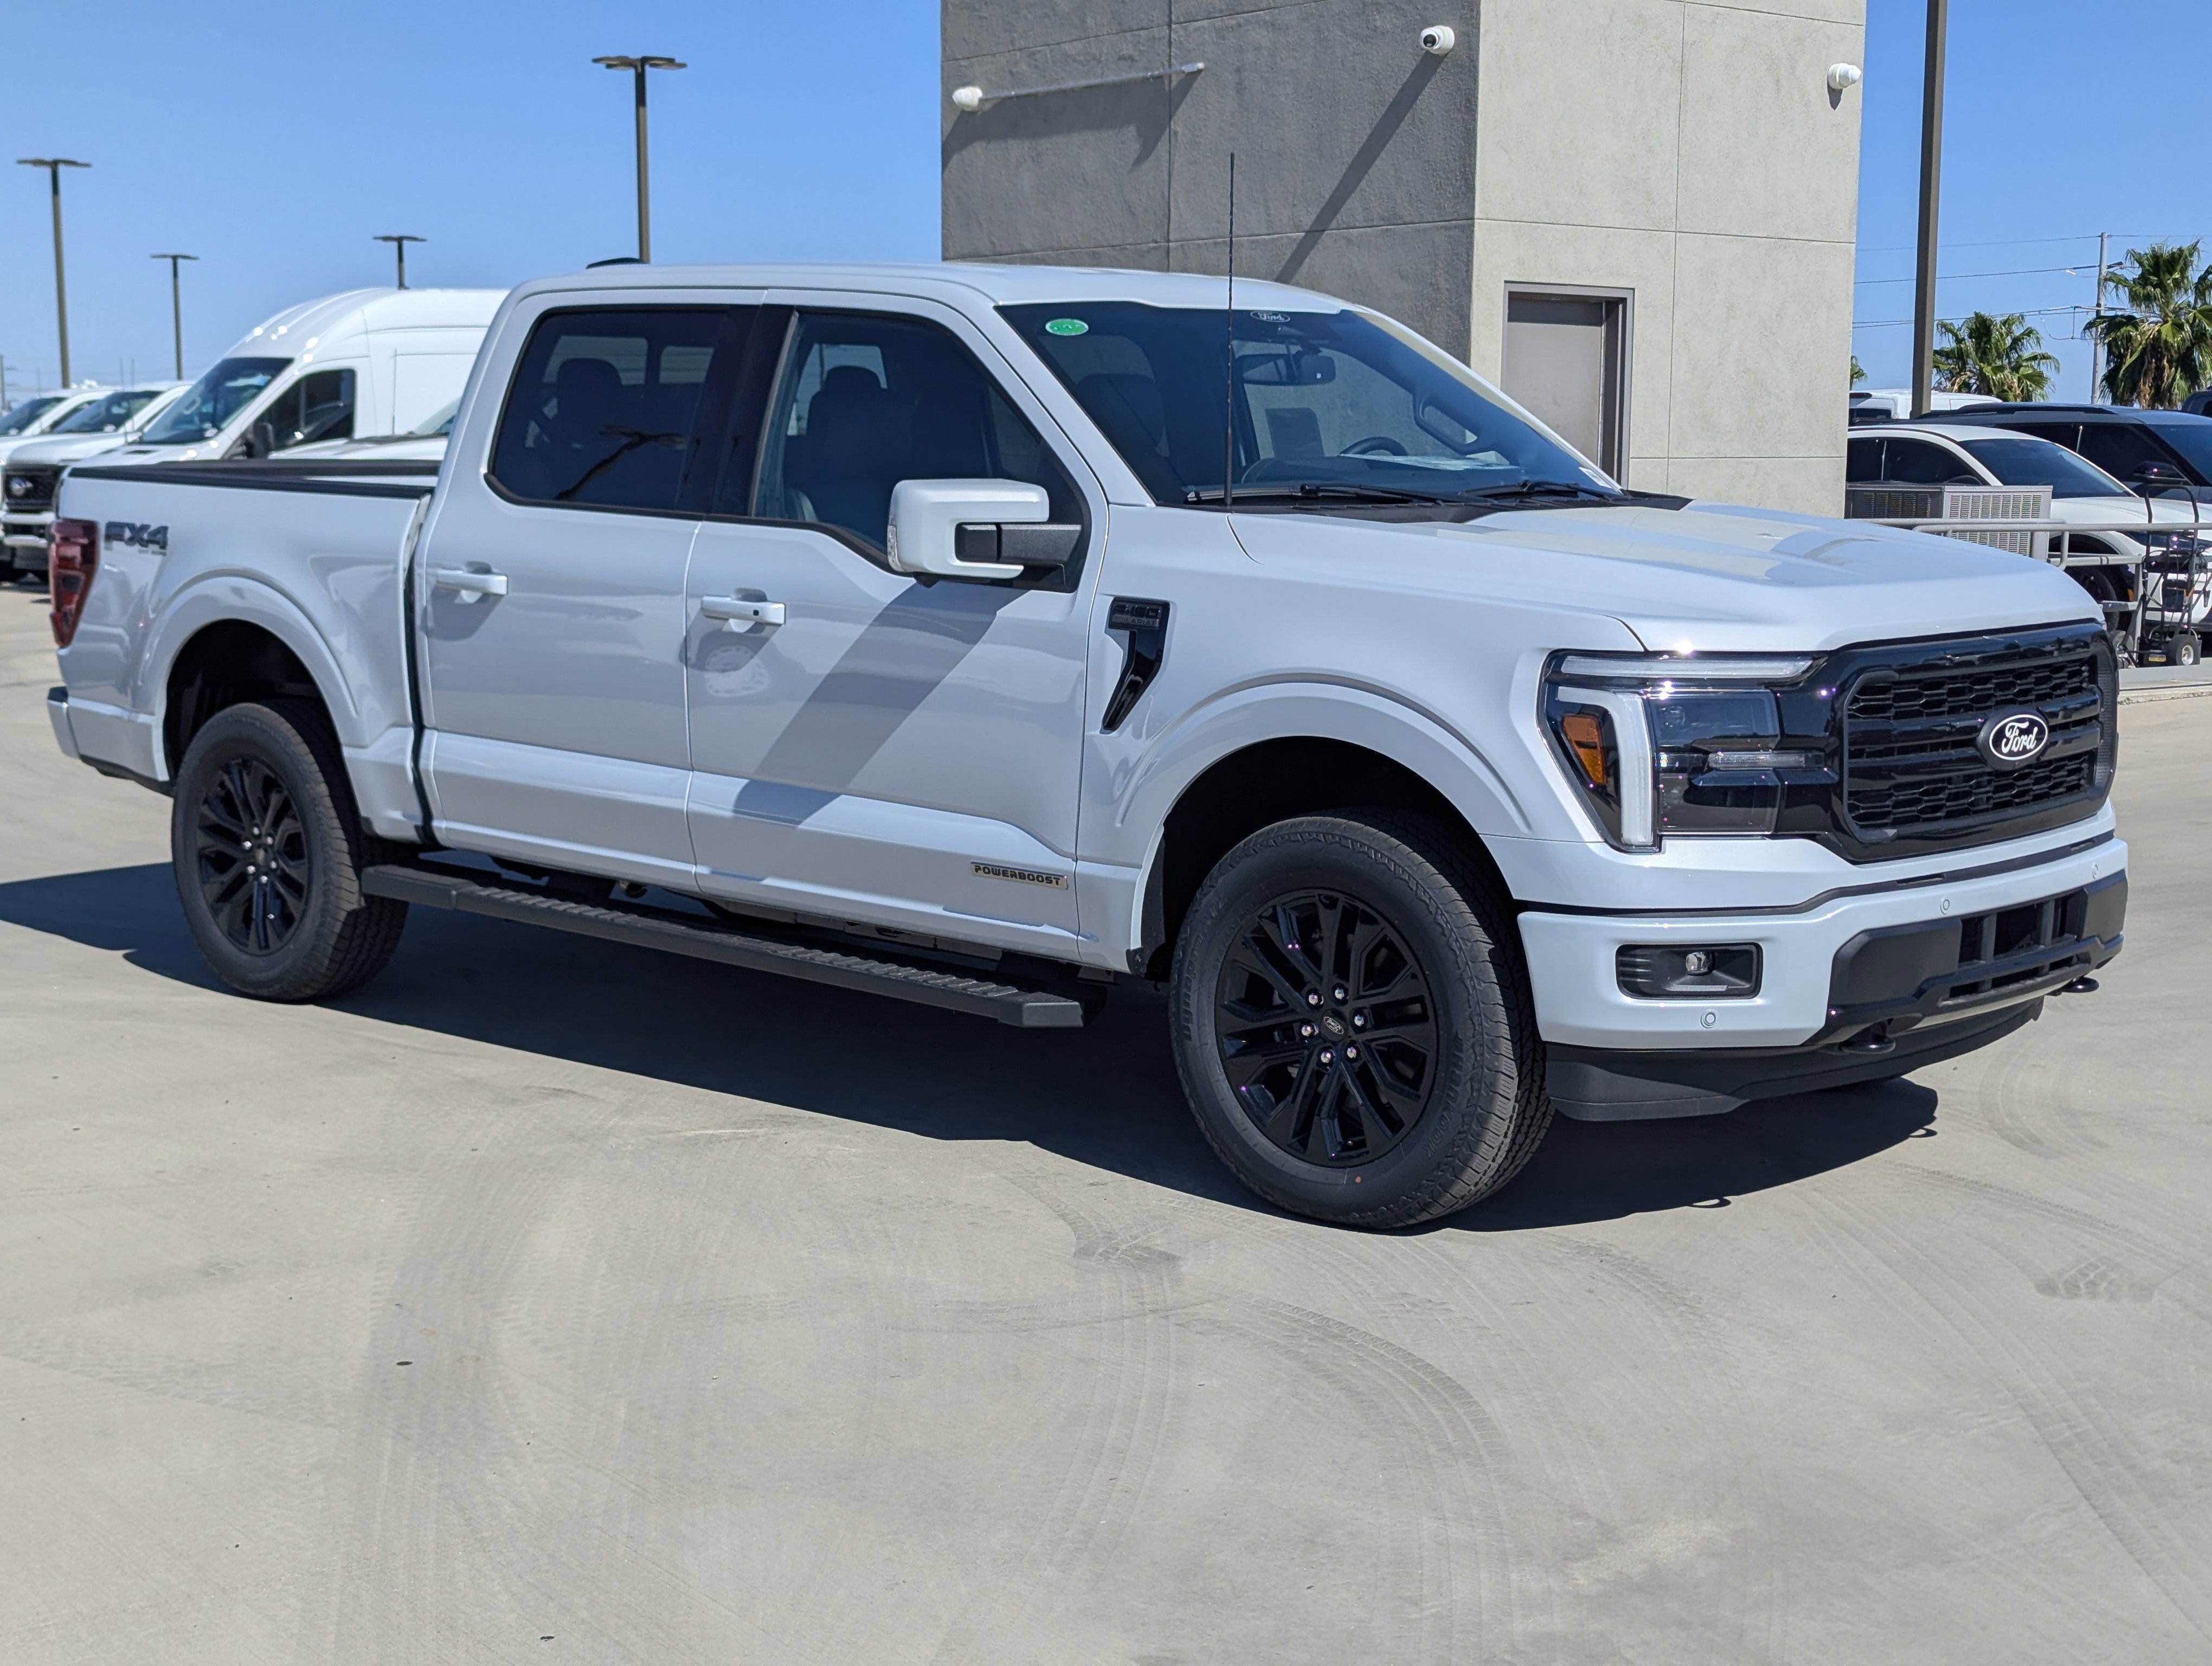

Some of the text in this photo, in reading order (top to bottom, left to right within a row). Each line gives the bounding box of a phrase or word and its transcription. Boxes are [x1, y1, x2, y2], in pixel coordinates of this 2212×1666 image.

[105, 521, 169, 551] FX4
[2001, 721, 2038, 753] Ford
[974, 864, 1060, 886] POWERBOOST
